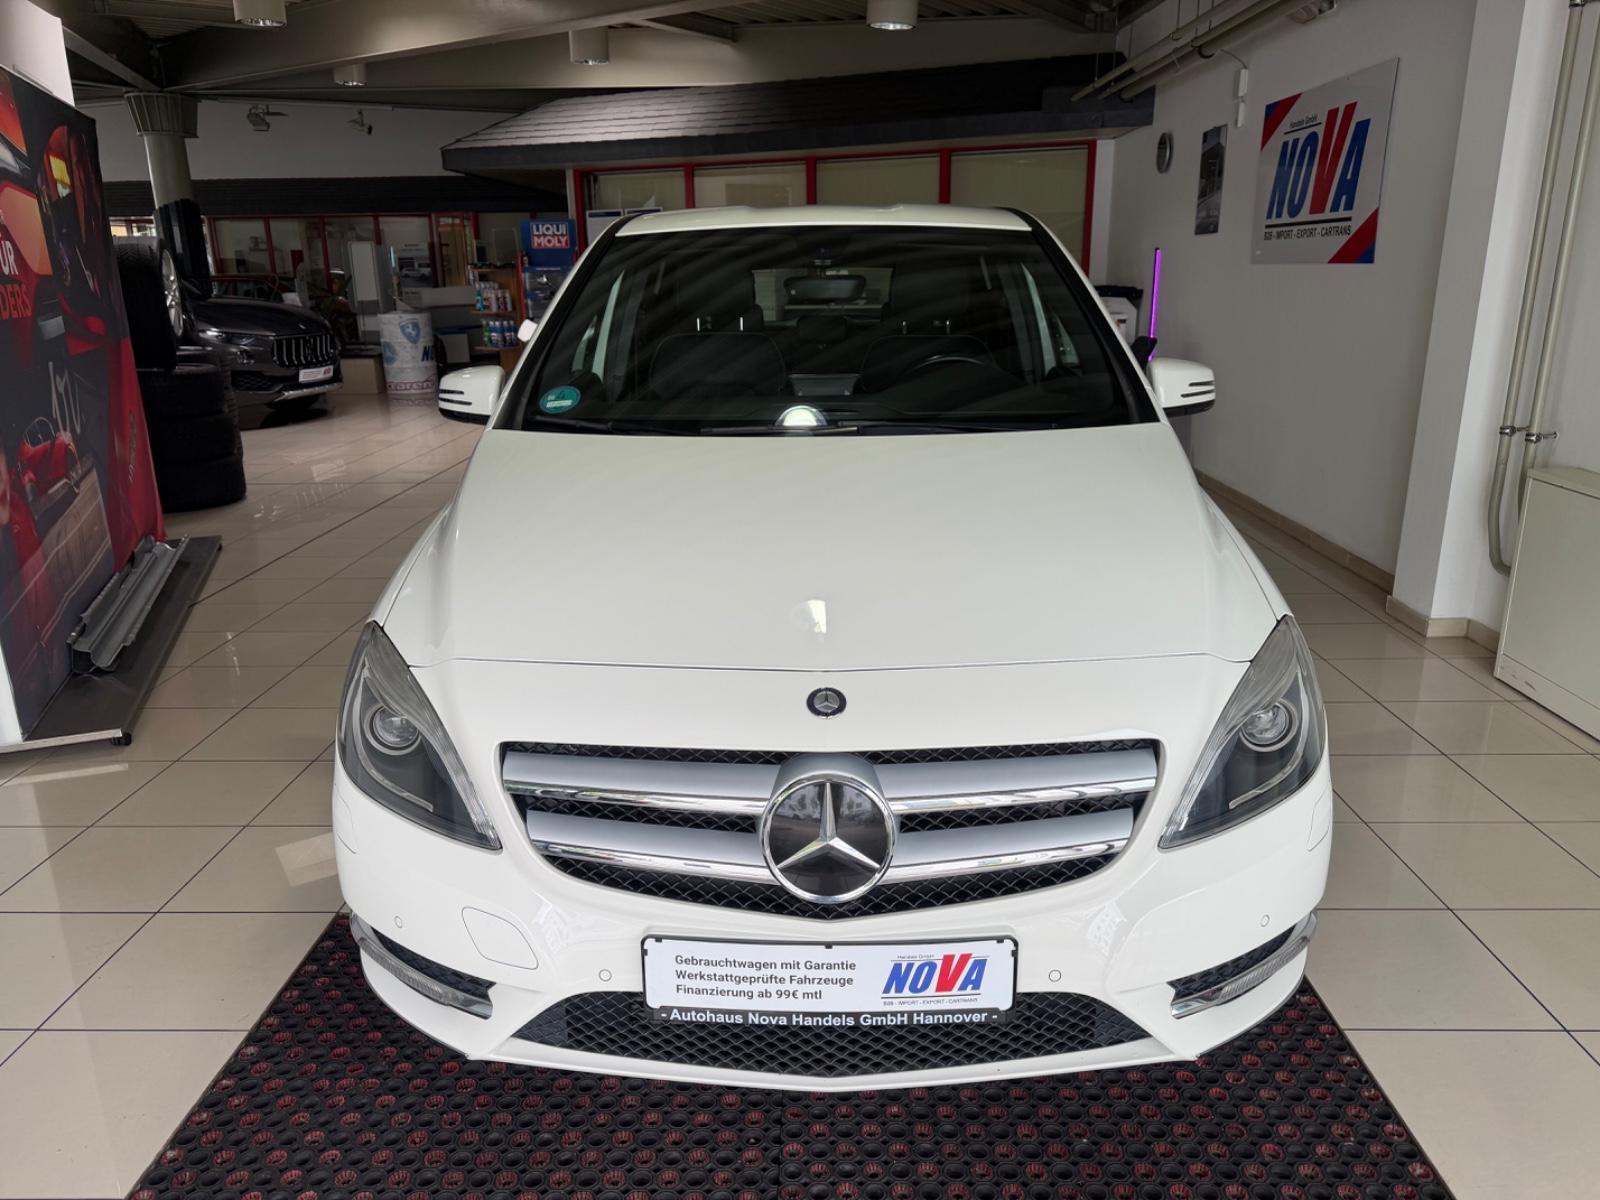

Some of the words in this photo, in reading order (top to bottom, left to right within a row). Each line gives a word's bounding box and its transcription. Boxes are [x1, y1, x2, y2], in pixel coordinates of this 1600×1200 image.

[1266, 101, 1371, 220] NOVA
[532, 223, 567, 236] LIQUI
[1296, 227, 1317, 239] EXPORT
[1320, 225, 1351, 238] CARTRANS
[533, 235, 568, 247] MOLY
[675, 955, 777, 971] Gebrauchtwagen
[780, 960, 801, 970] mit
[804, 960, 857, 970] Garantie
[675, 970, 786, 985] Werkstattgeprüfte
[789, 975, 854, 987] Fahrzeuge
[882, 953, 988, 994] NOVA
[676, 985, 754, 1000] Finanzierung
[757, 989, 772, 999] ab
[775, 989, 799, 999] 99€
[802, 990, 822, 1000] mtl
[669, 1008, 744, 1023] Autohaus
[748, 1012, 787, 1025] Nova
[792, 1013, 855, 1026] Handels
[859, 1012, 908, 1026] GmbH
[913, 1010, 988, 1025] Hannover
